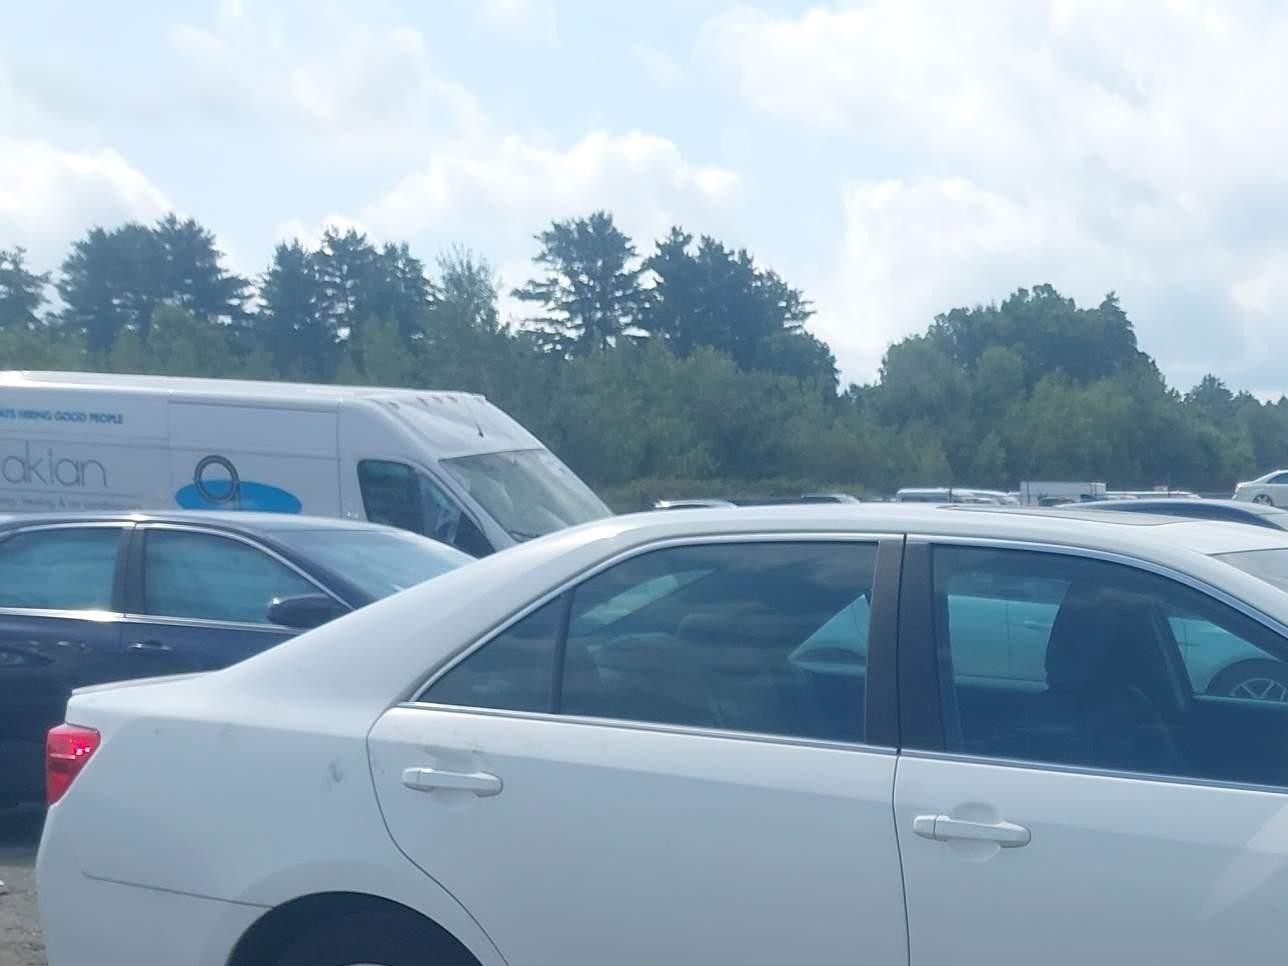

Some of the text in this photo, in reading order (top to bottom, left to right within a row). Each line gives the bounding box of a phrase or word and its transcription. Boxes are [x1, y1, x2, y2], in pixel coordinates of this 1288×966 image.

[54, 411, 87, 422] GOOD
[89, 412, 123, 424] PEOPLE
[2, 440, 108, 487] akian
